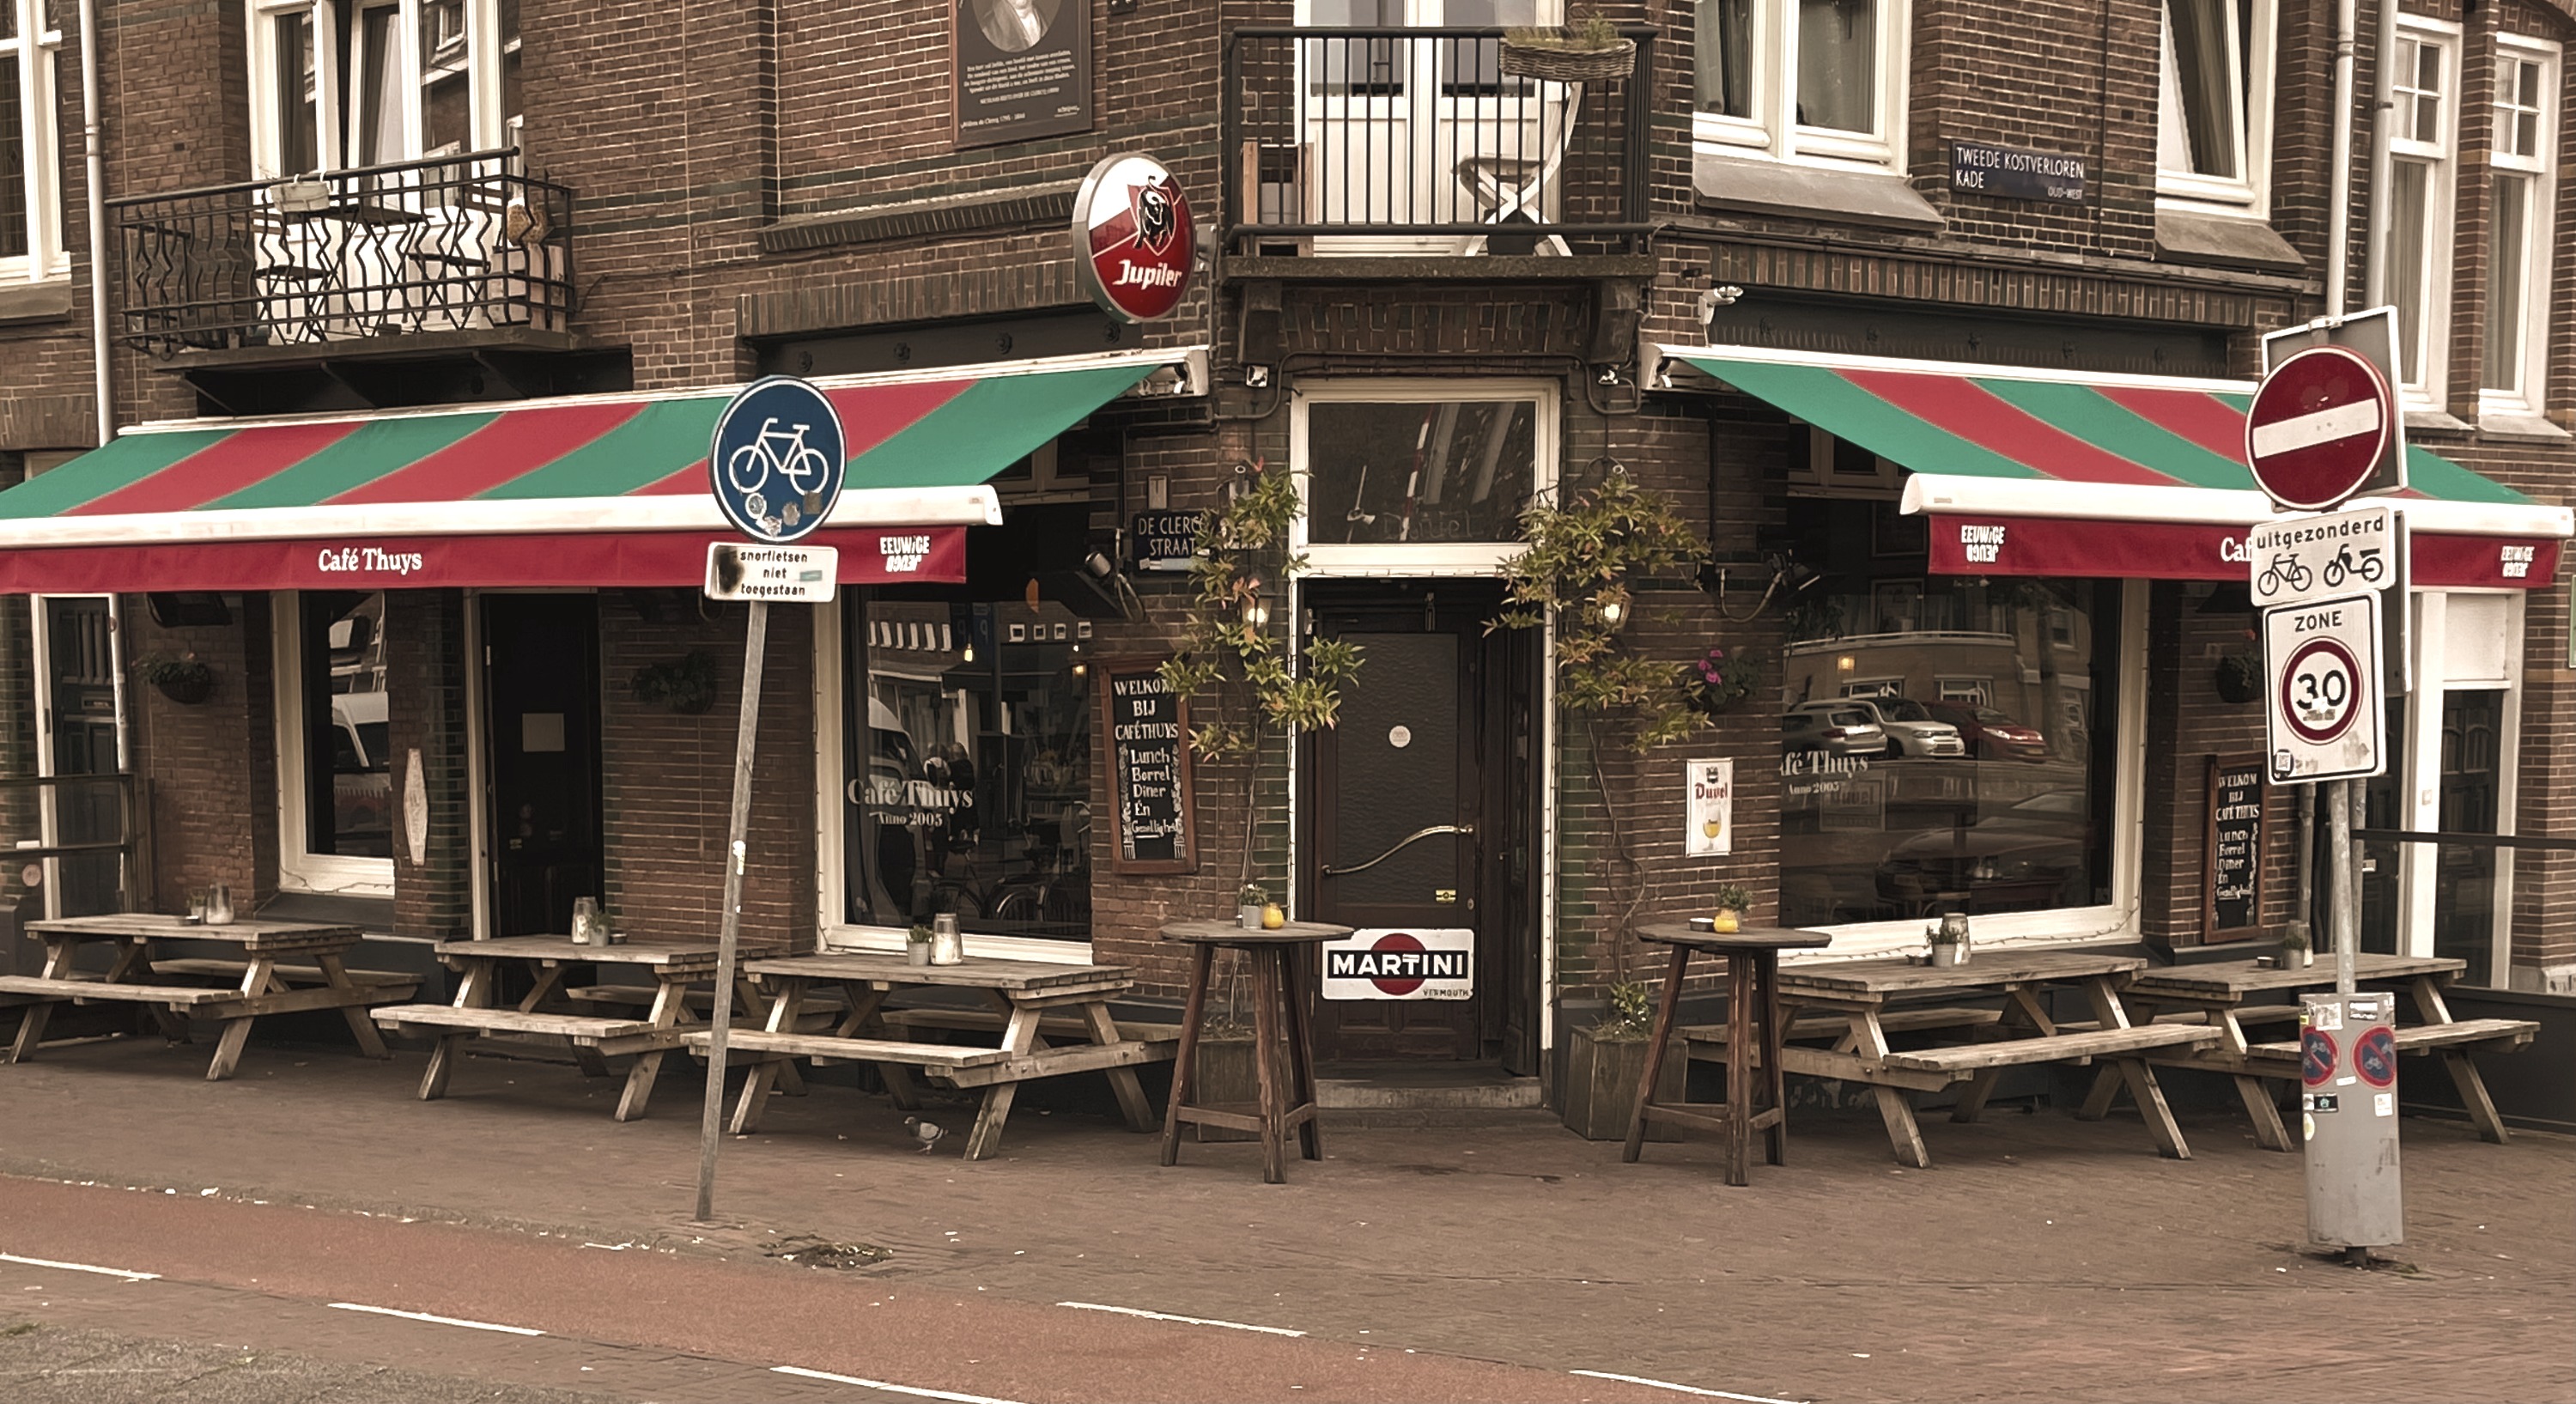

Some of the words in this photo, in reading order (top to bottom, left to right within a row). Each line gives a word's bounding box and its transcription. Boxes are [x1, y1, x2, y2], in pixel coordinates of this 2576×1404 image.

[1956, 147, 2001, 169] TWEEDE
[2004, 153, 2085, 179] KOSTVERLOREN
[1956, 169, 1984, 189] KADE
[1112, 258, 1182, 290] Jupiler
[1138, 517, 1155, 535] DE
[2257, 515, 2385, 550] uitgezonderd
[1150, 538, 1196, 556] STRAAT
[2221, 537, 2251, 562] Caf
[319, 547, 359, 572] Café
[361, 547, 422, 575] Thuys
[740, 550, 808, 563] snorfietsen
[762, 567, 787, 579] niet
[741, 583, 805, 598] toegestaan
[2294, 611, 2342, 632] ZONE
[2296, 670, 2346, 710] 30
[1133, 700, 1156, 716] BIJ
[1131, 747, 1170, 764] Lunch
[1807, 750, 1868, 779] Thuys
[1132, 765, 1170, 781] Borrel
[848, 778, 900, 805] Café
[902, 780, 973, 814] Thuys
[1133, 783, 1166, 798] Diner
[1695, 782, 1728, 799] Duvel
[1789, 784, 1812, 795] Anno
[1812, 781, 1839, 793] 2005
[878, 811, 907, 824] Anno
[909, 811, 943, 827] 2005
[1333, 953, 1463, 976] MARTINI
